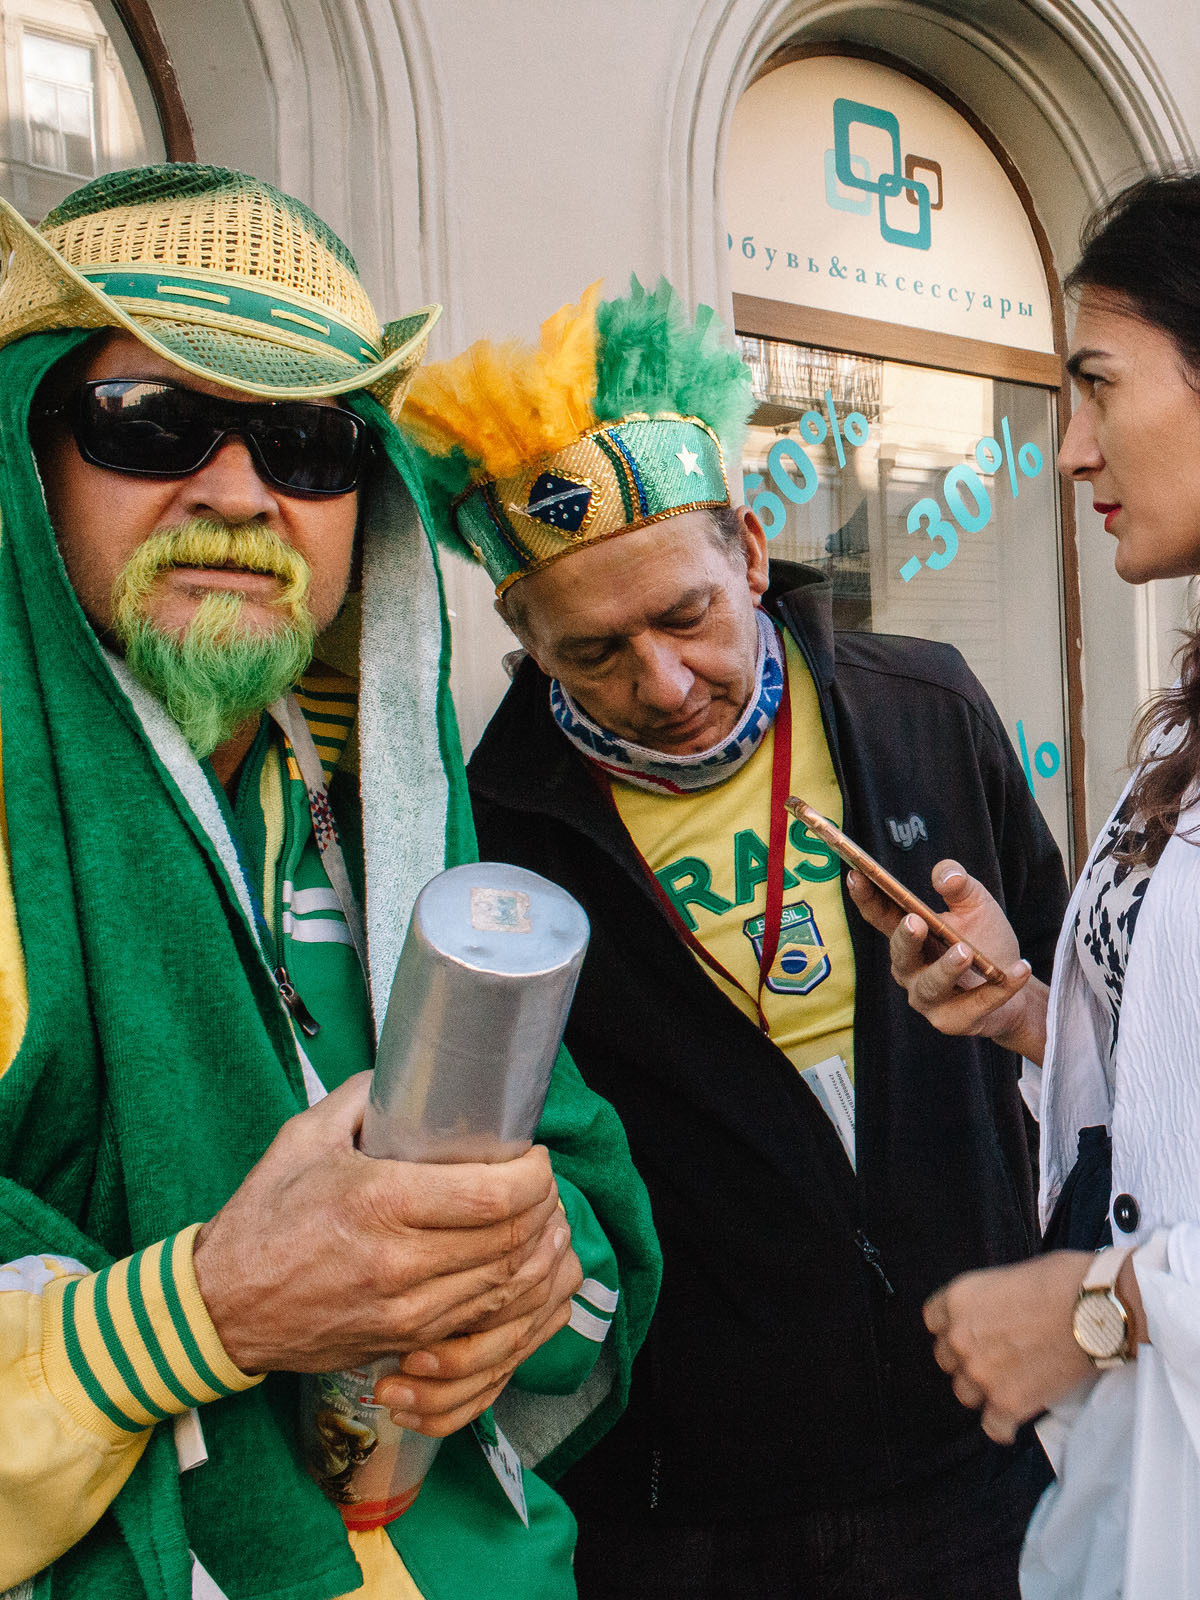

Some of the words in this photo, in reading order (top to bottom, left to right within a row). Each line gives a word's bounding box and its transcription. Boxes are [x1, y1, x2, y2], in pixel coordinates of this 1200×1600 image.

[899, 415, 1044, 583] -30%
[887, 815, 928, 848] lyft
[653, 816, 842, 932] RAS
[755, 909, 802, 932] BSIL
